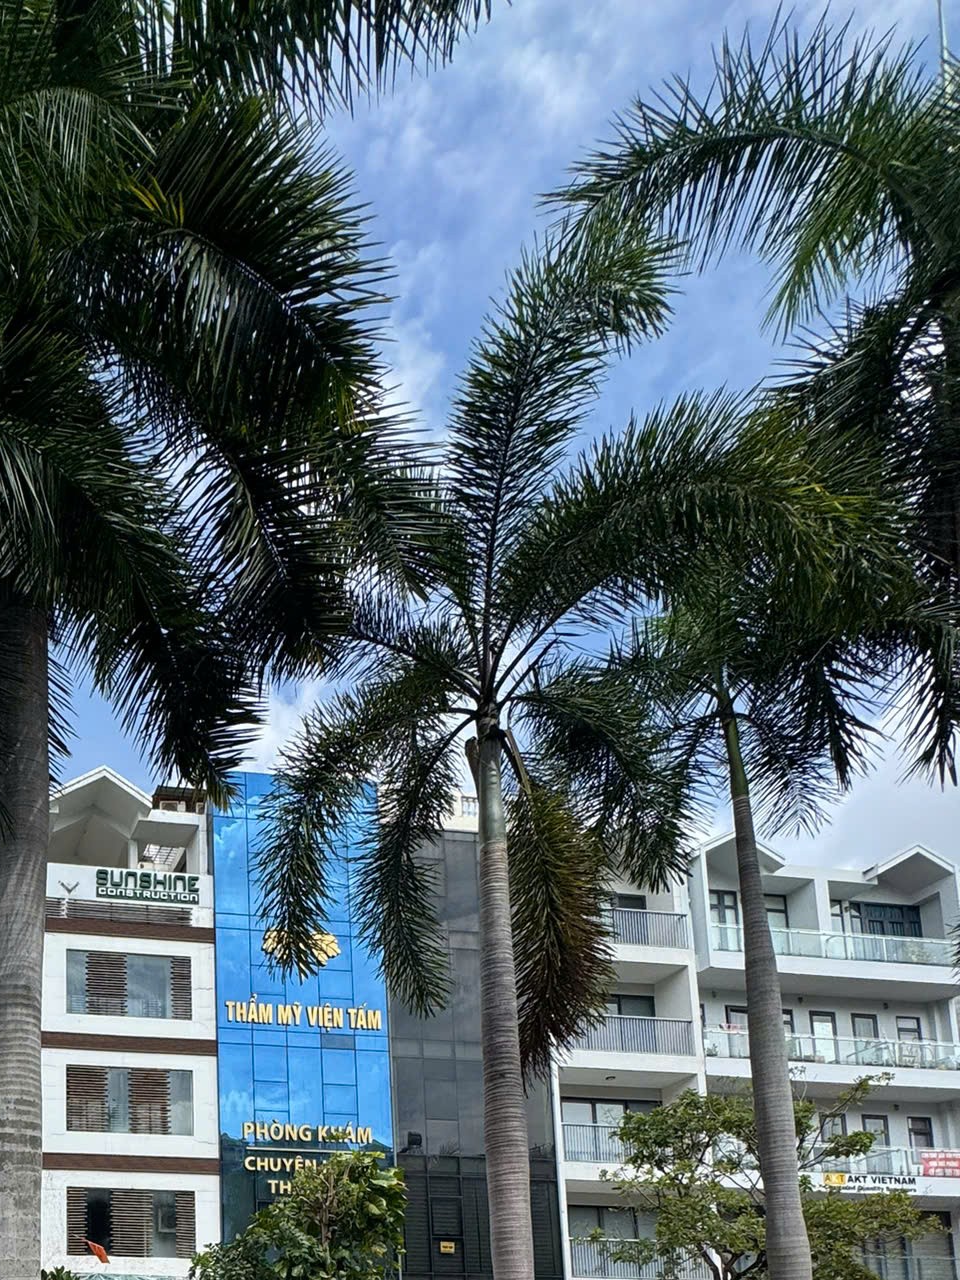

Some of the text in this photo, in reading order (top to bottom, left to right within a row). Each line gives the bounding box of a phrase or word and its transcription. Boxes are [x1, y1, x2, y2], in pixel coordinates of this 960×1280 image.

[95, 869, 200, 893] SUNSHINE
[97, 887, 199, 902] CONSTRUCTION
[225, 993, 273, 1024] THẨM
[277, 1001, 302, 1026] MỸ
[306, 1003, 344, 1032] VIỆN
[243, 1120, 312, 1141] PHÒNG
[244, 1156, 317, 1172] CHUYÊN
[847, 1175, 916, 1185] AKT VIETNAM
